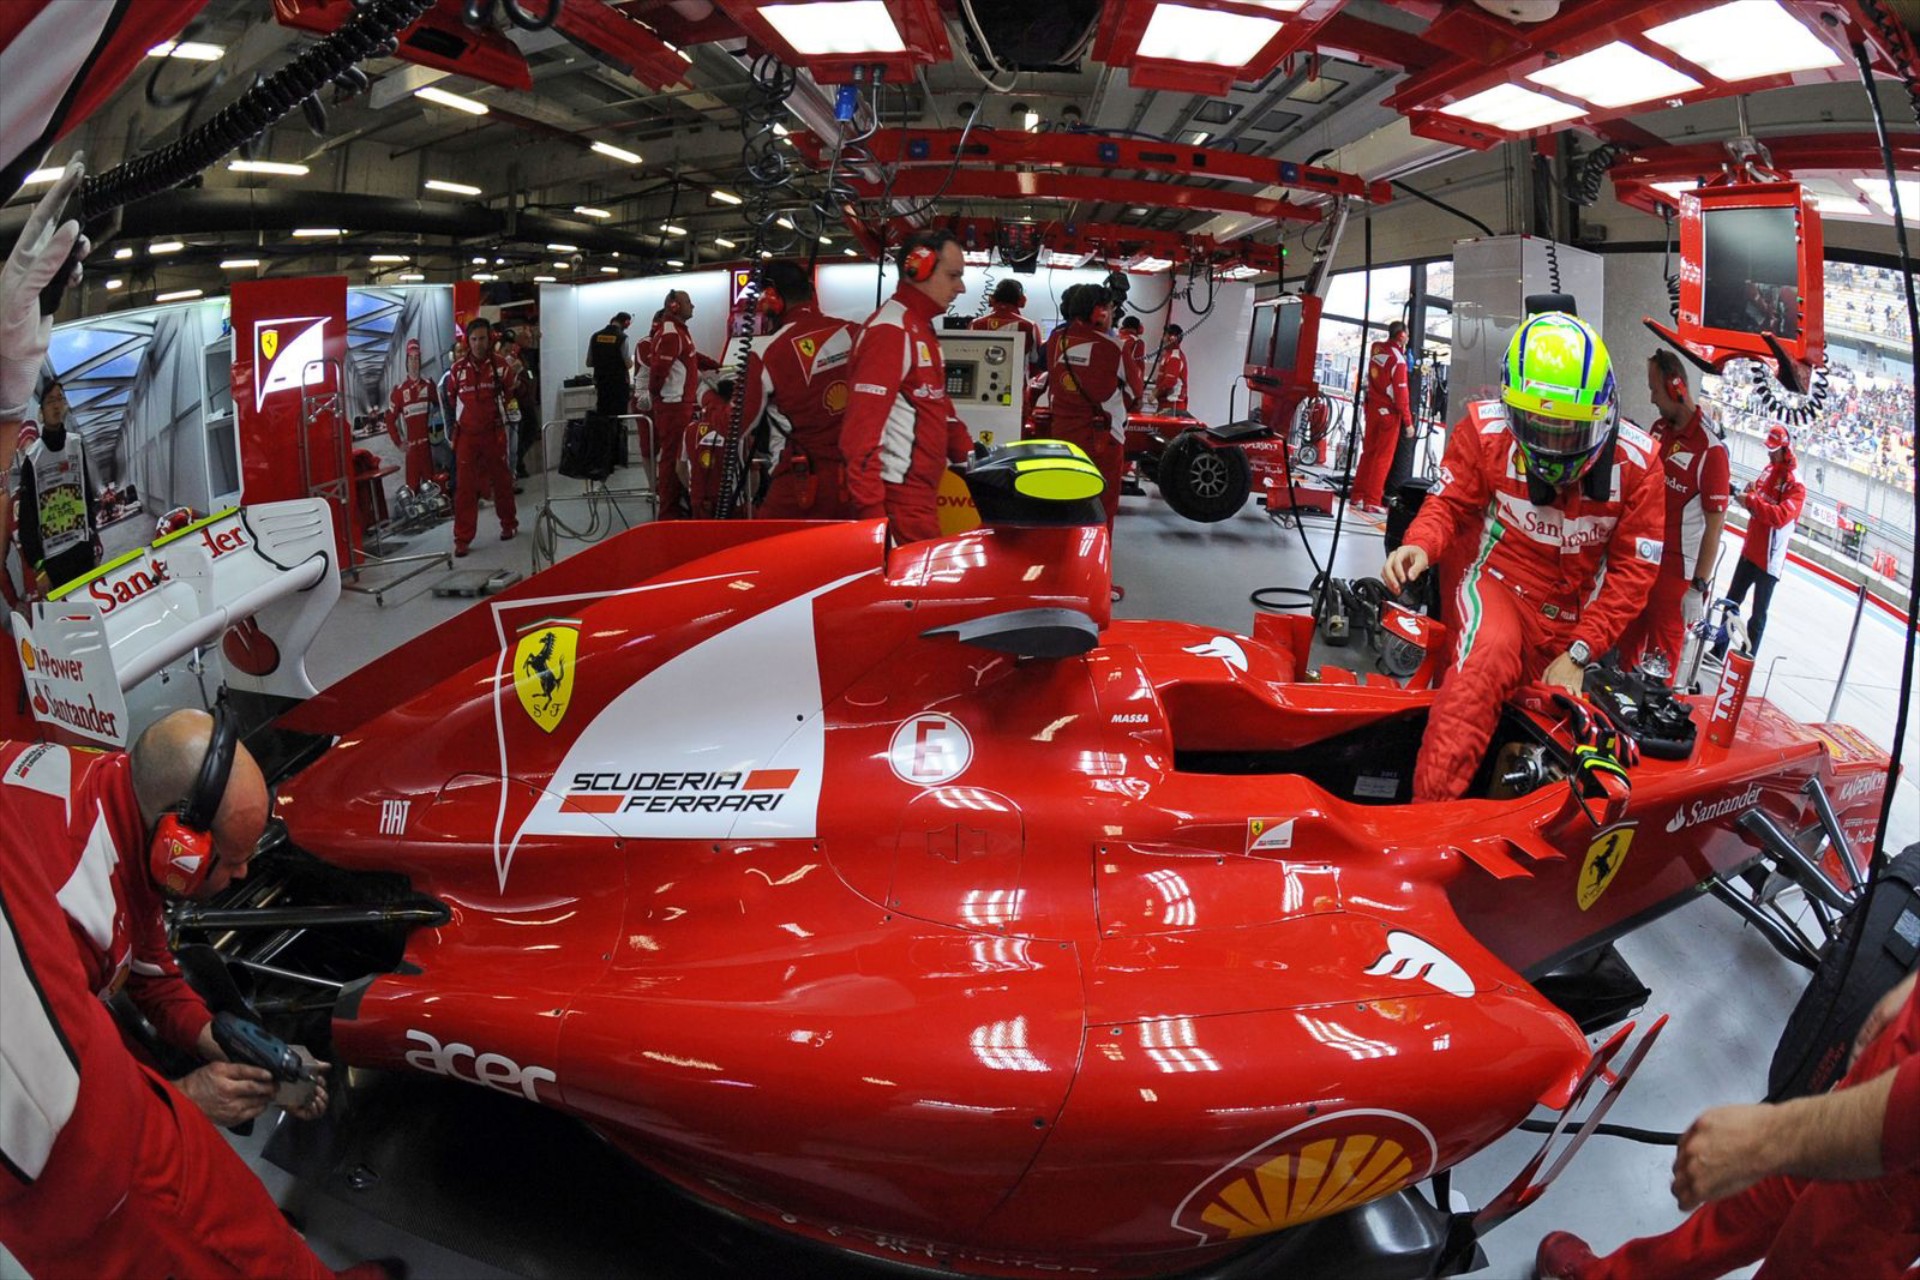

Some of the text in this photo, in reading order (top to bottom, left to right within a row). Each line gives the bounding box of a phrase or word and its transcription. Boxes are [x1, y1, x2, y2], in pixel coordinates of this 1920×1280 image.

[1126, 425, 1160, 434] antander
[34, 646, 84, 682] V-Power
[1711, 659, 1742, 723] TNT
[44, 683, 120, 739] Santander
[1111, 713, 1149, 724] MASSA
[912, 721, 946, 777] E
[570, 771, 743, 791] SCUDERIA
[379, 799, 412, 836] FIAT
[623, 793, 785, 813] FERRARI
[1686, 783, 1764, 828] Santander
[405, 1028, 557, 1104] acer
